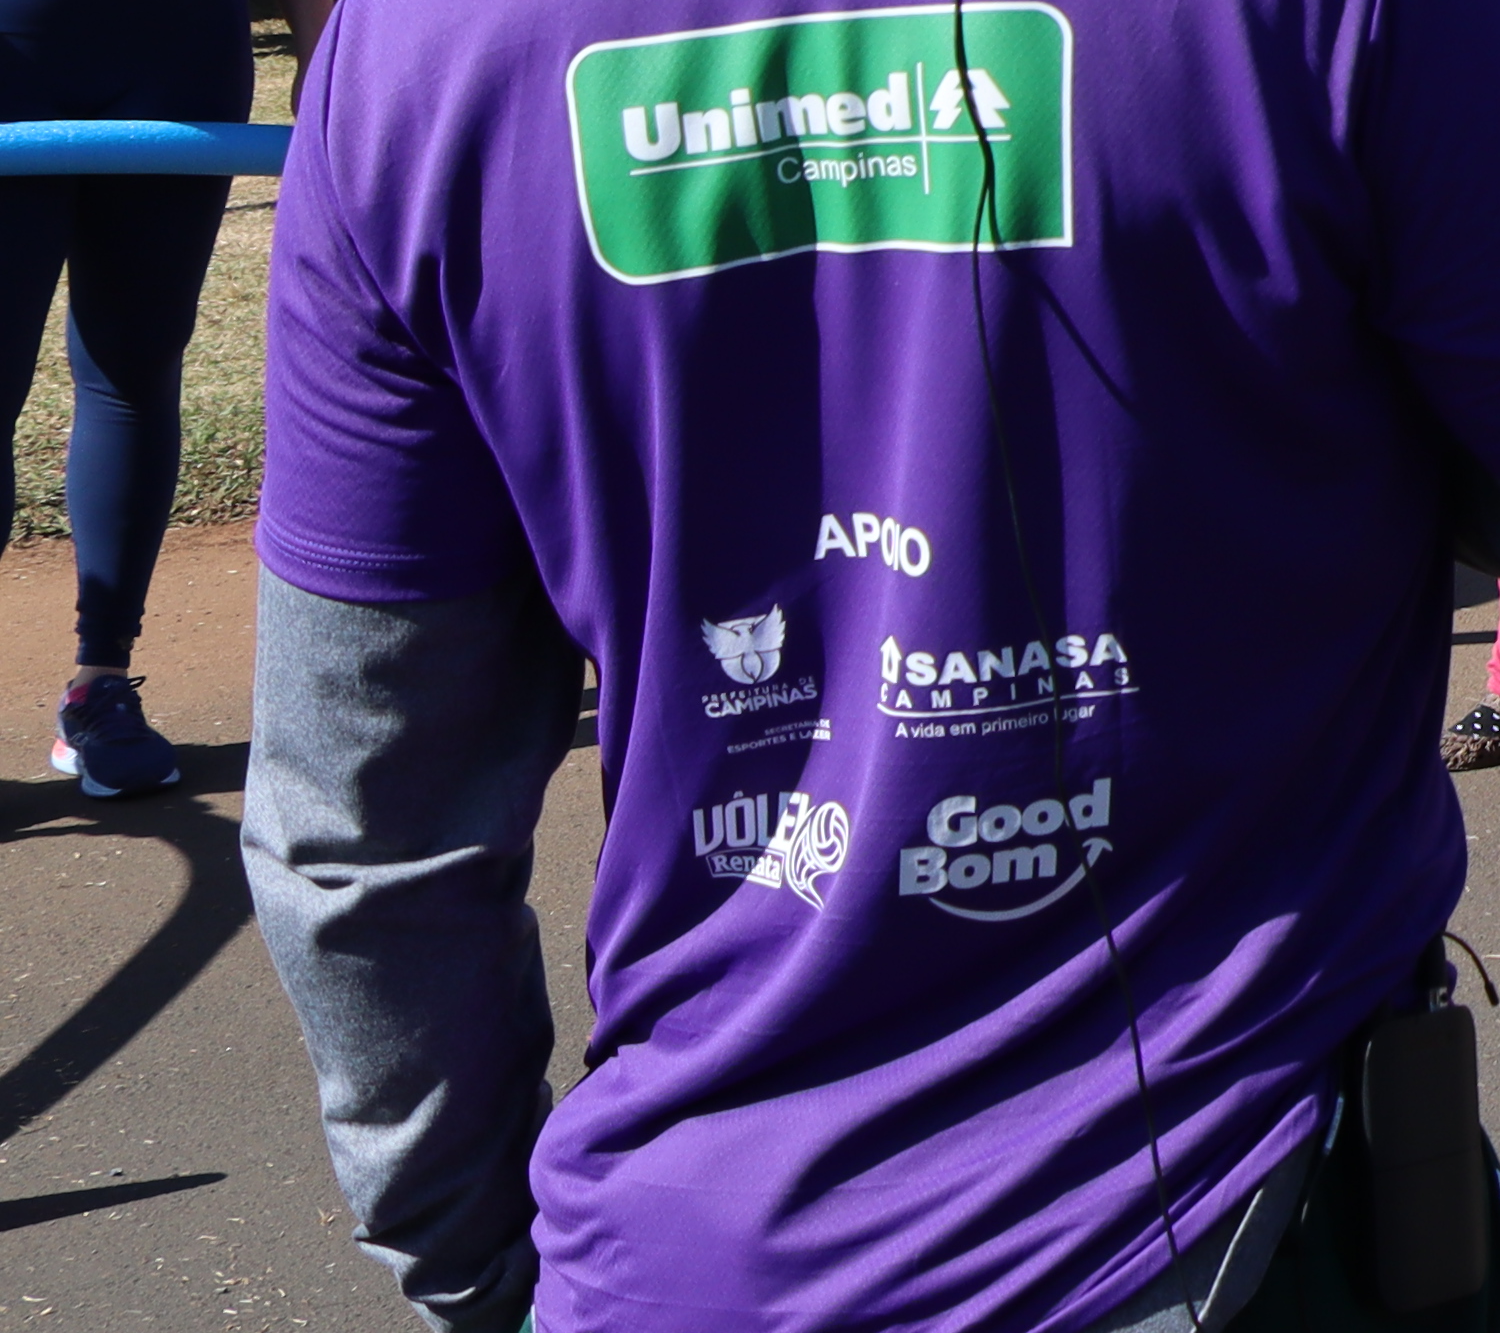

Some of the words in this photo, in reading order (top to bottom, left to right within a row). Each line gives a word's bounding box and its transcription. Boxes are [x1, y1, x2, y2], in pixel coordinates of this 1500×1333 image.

[621, 71, 913, 162] Unimed
[776, 153, 918, 188] Campinas
[813, 512, 931, 577] APOIO
[905, 633, 1128, 686] SANASA
[701, 682, 789, 703] PREFEITURA
[798, 675, 814, 685] DE
[704, 684, 818, 718] CAMPINAS
[727, 735, 787, 754] ESPORTES
[789, 733, 797, 742] E
[798, 729, 831, 741] LAZER
[894, 722, 908, 738] A
[911, 722, 946, 739] vida
[949, 722, 977, 737] em
[981, 711, 1049, 736] primeiro
[926, 777, 1112, 848] Good
[711, 854, 782, 881] Renata
[898, 843, 1058, 896] Bom
